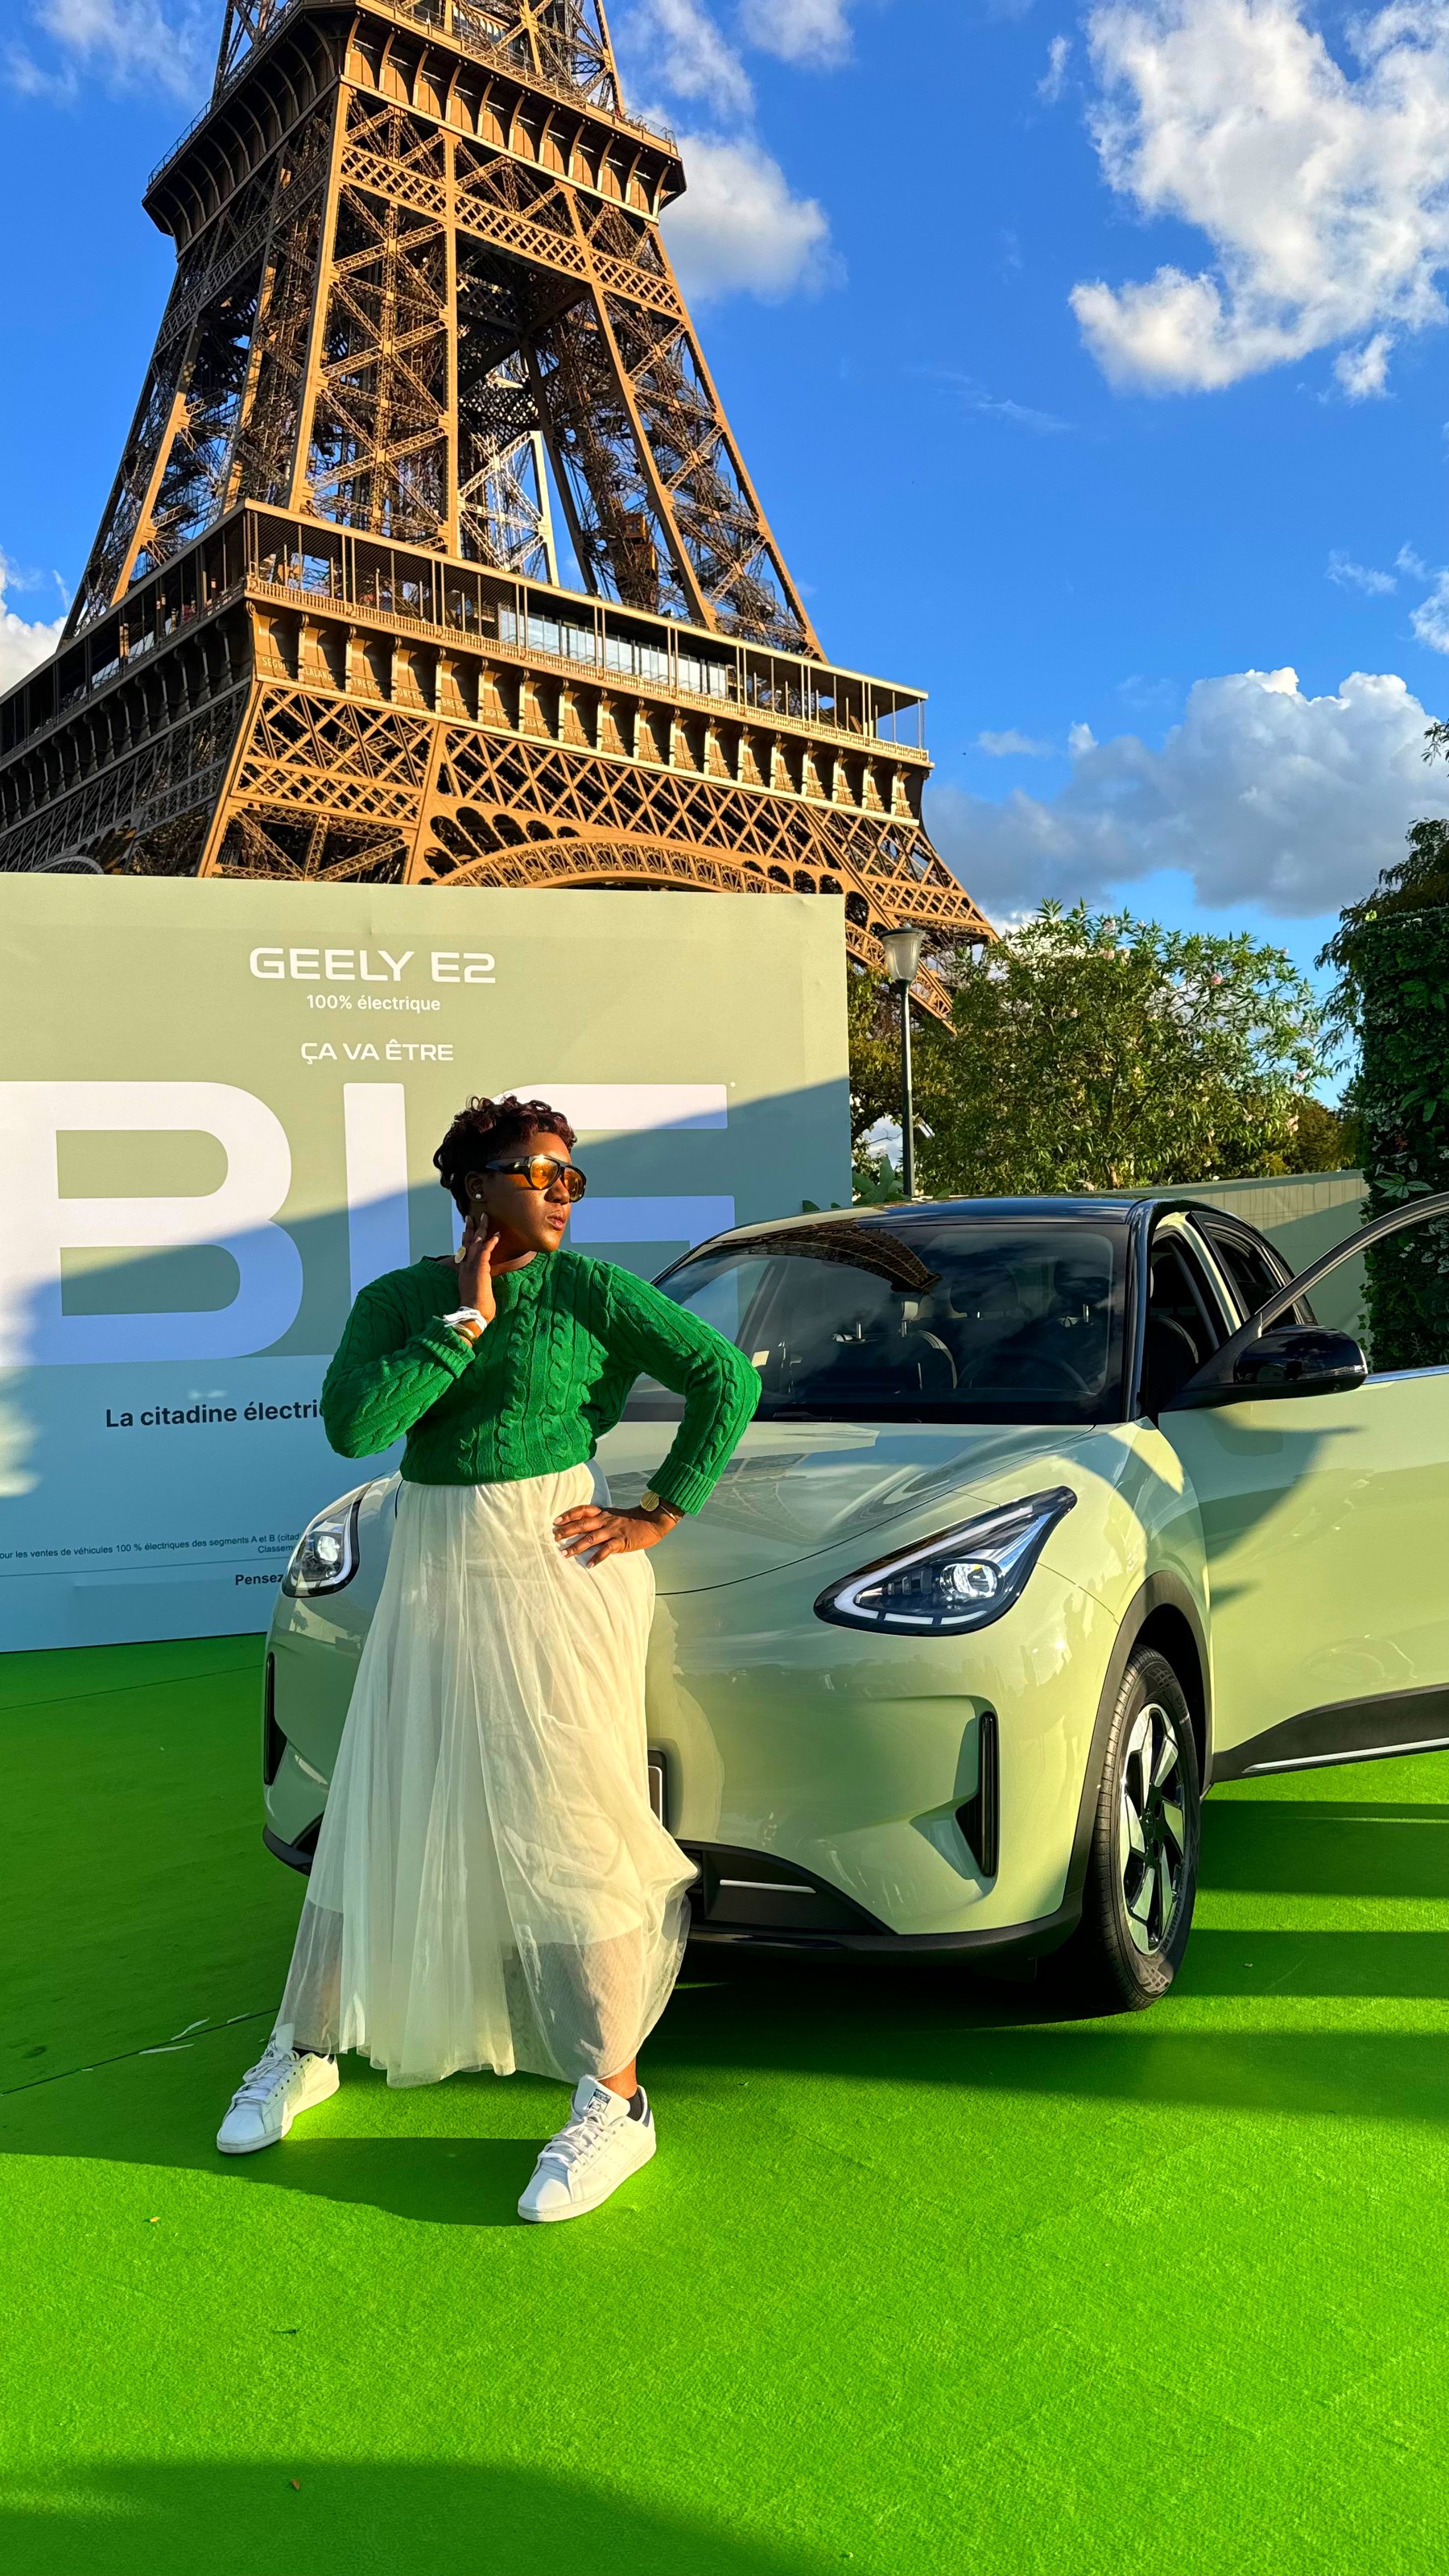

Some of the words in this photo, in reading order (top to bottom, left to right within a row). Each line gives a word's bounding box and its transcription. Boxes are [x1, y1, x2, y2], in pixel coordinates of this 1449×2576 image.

[250, 947, 415, 981] GEELY
[431, 952, 496, 983] E2
[306, 994, 353, 1009] 100%
[357, 995, 441, 1013] électrique
[301, 1042, 337, 1064] ÇA
[342, 1043, 380, 1060] VA
[385, 1038, 454, 1061] ÊTRE
[105, 1409, 134, 1427] La
[140, 1404, 237, 1426] citadine
[15, 1550, 28, 1558] les
[31, 1549, 59, 1558] ventes
[60, 1547, 72, 1556] de
[74, 1544, 114, 1555] véhicules
[116, 1544, 131, 1552] 100
[134, 1543, 142, 1551] %
[144, 1539, 190, 1550] électriques
[192, 1539, 207, 1547] des
[209, 1536, 249, 1547] segments
[250, 1535, 258, 1543] A
[269, 1534, 275, 1542] B
[258, 1545, 293, 1554] Classem
